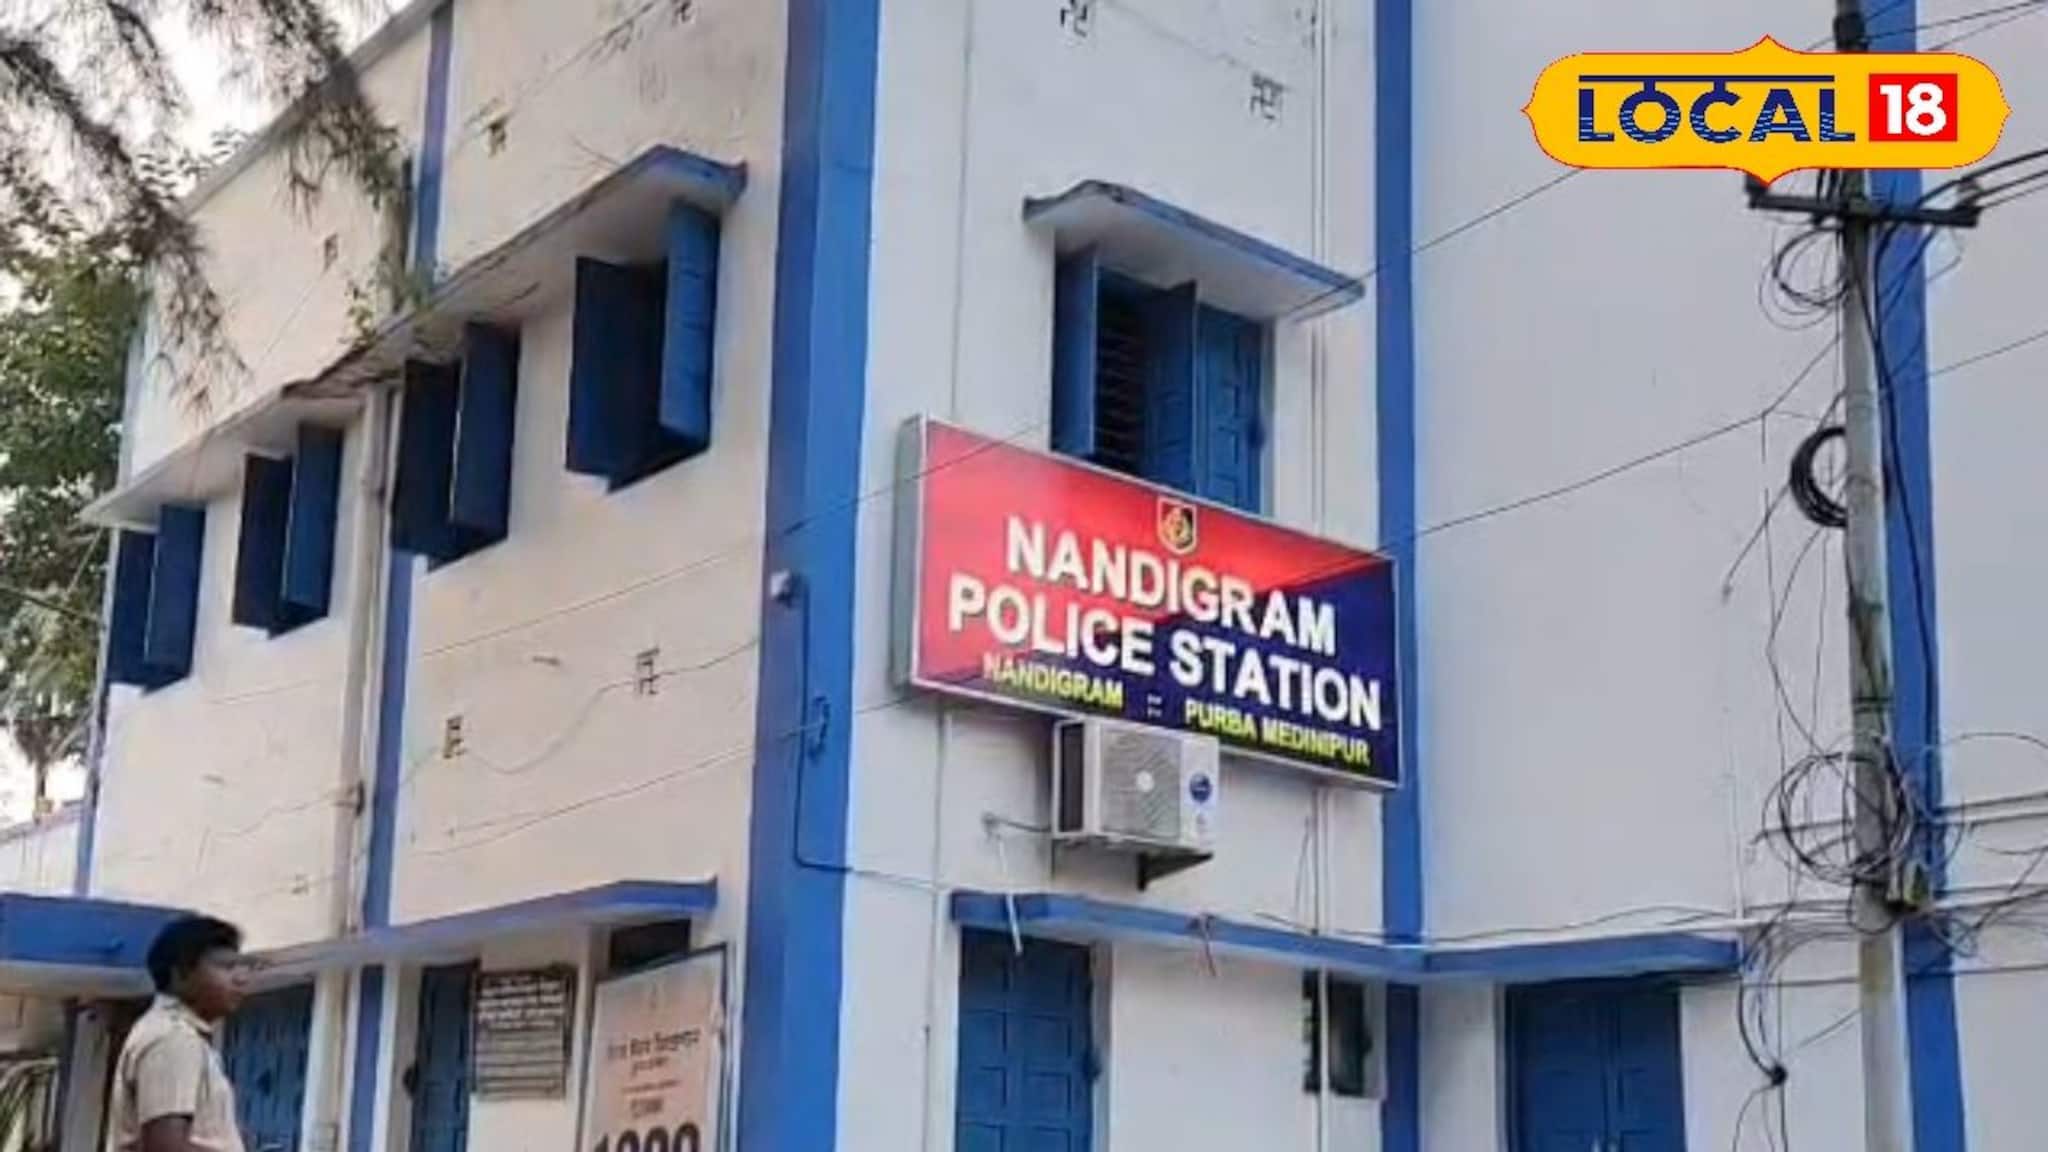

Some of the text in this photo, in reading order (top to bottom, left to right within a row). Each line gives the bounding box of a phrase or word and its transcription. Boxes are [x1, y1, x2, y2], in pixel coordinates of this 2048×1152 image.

[948, 571, 1382, 731] POLICE STATION
[1006, 515, 1337, 657] NANDIGRAM
[983, 652, 1124, 710] NANDIGRAM
[1184, 698, 1257, 743] PURBA
[1260, 720, 1372, 767] MEDINIPUR
